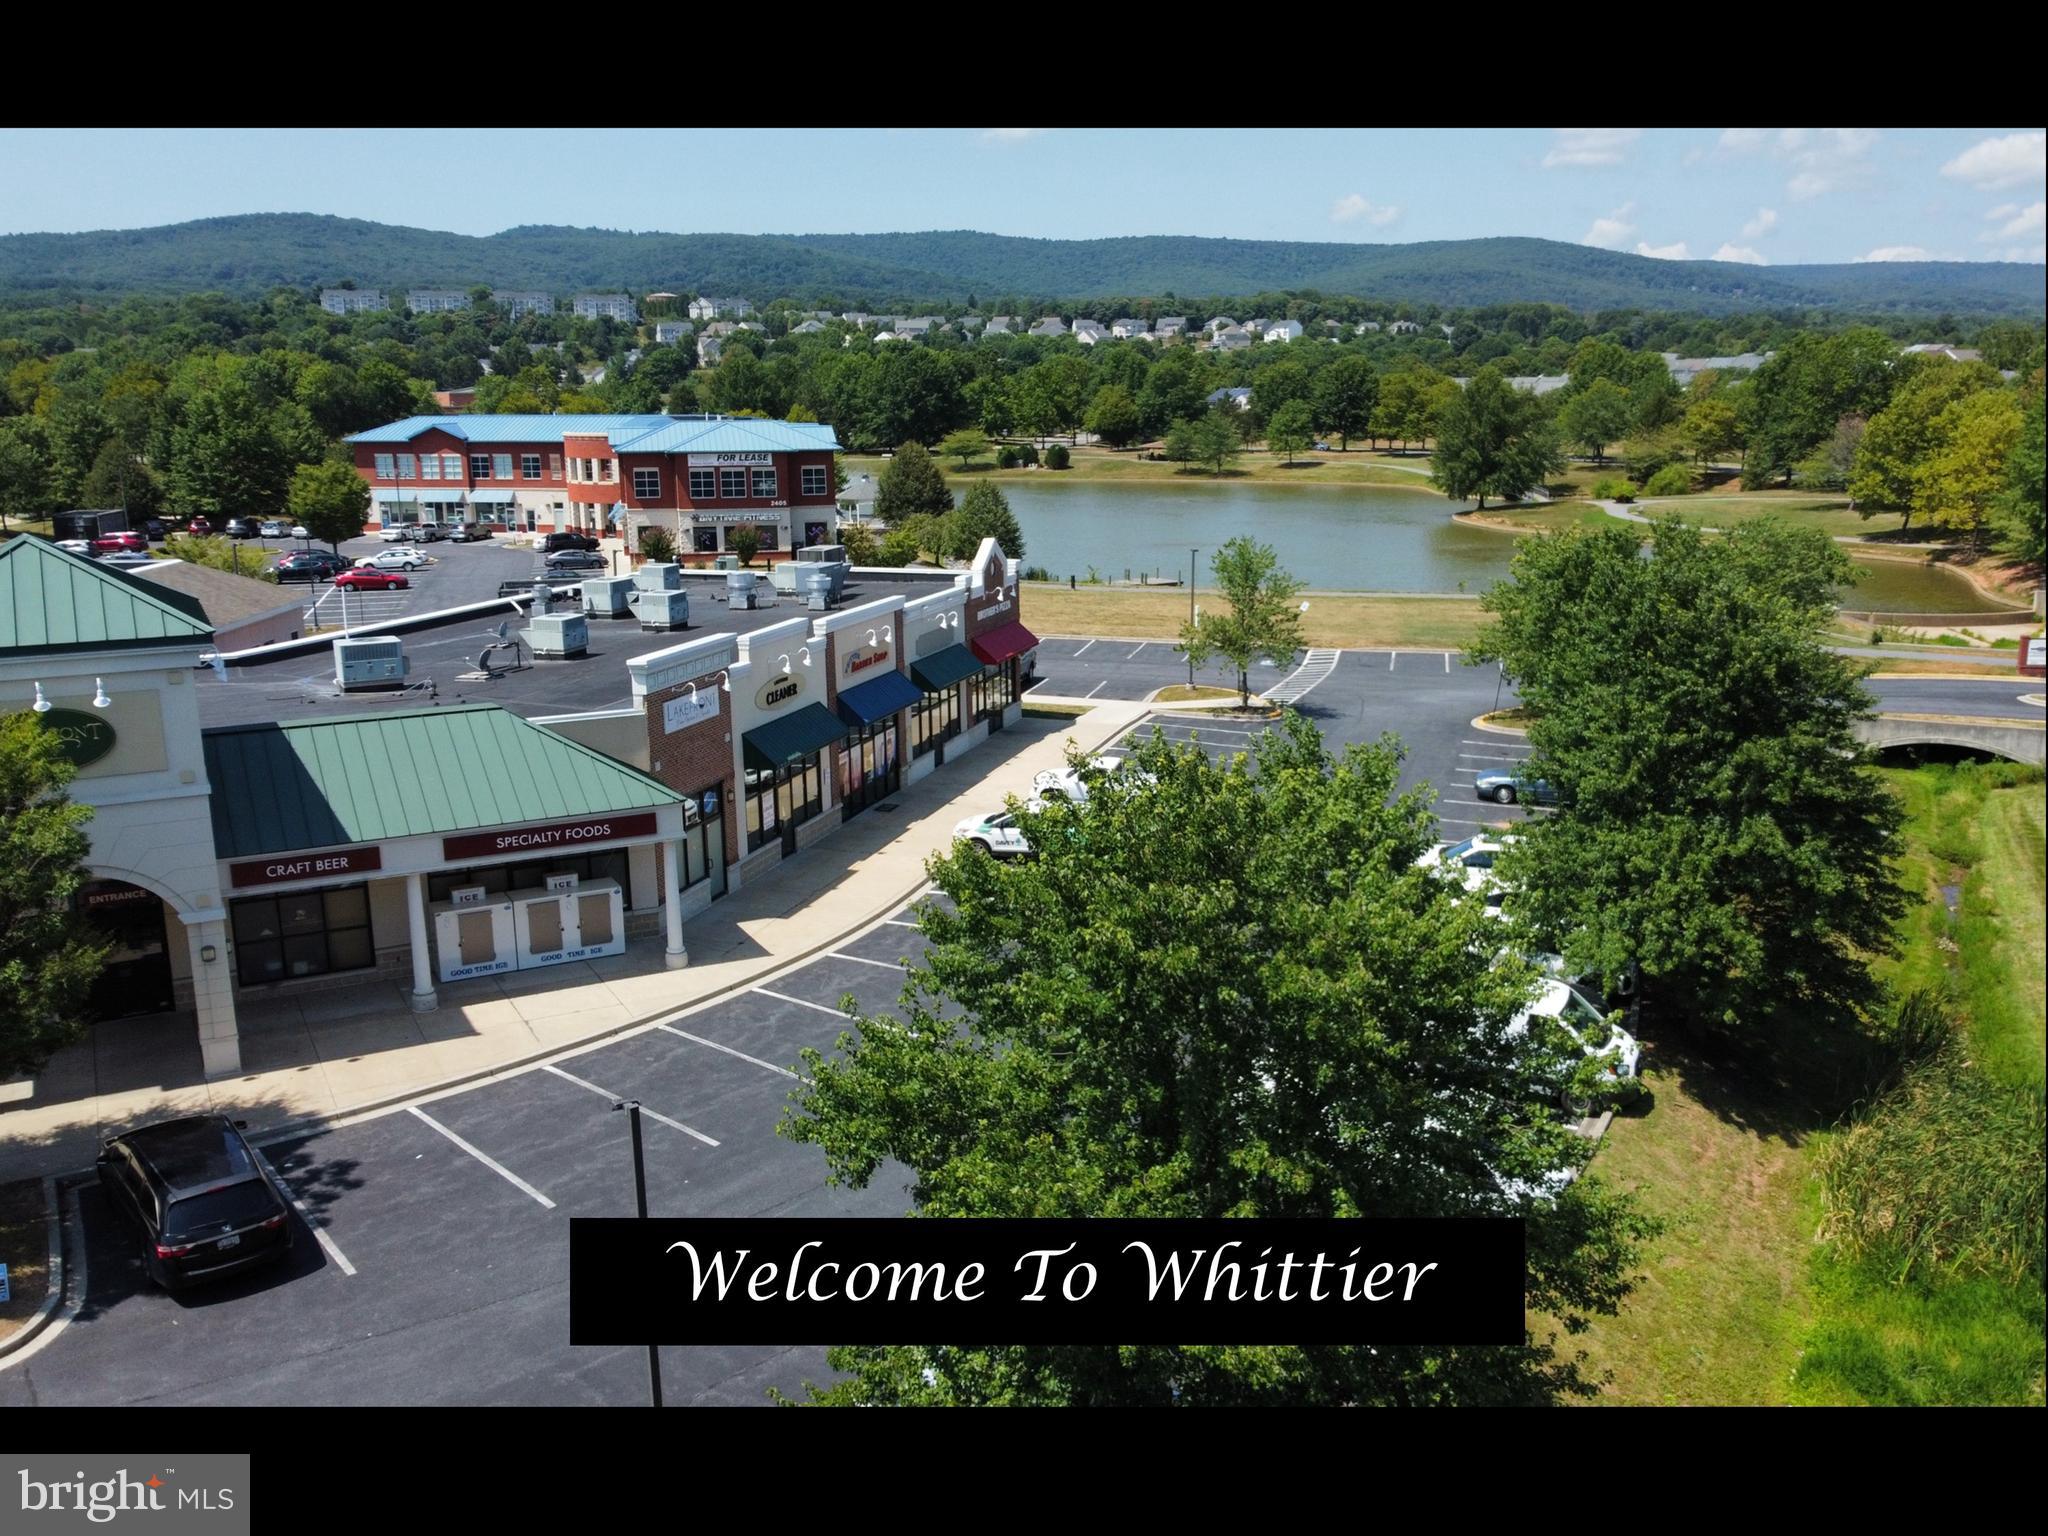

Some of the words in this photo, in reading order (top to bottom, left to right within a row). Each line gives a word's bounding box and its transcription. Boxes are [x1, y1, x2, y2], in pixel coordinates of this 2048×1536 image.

[717, 454, 736, 462] FOR
[739, 453, 769, 462] LEASE
[743, 512, 782, 521] FITNESS
[766, 683, 798, 706] CLEANER
[496, 830, 561, 849] SPECIALTY
[565, 824, 611, 840] FOODS
[265, 862, 311, 878] CRAFT
[316, 857, 349, 871] BEER
[553, 880, 573, 889] ICE
[88, 889, 148, 904] ENTRANCE
[459, 893, 479, 902] ICE
[540, 952, 563, 962] GOOD
[567, 949, 586, 959] TIME
[590, 946, 604, 954] ICE
[450, 966, 473, 977] GOOD
[474, 963, 494, 974] TIME
